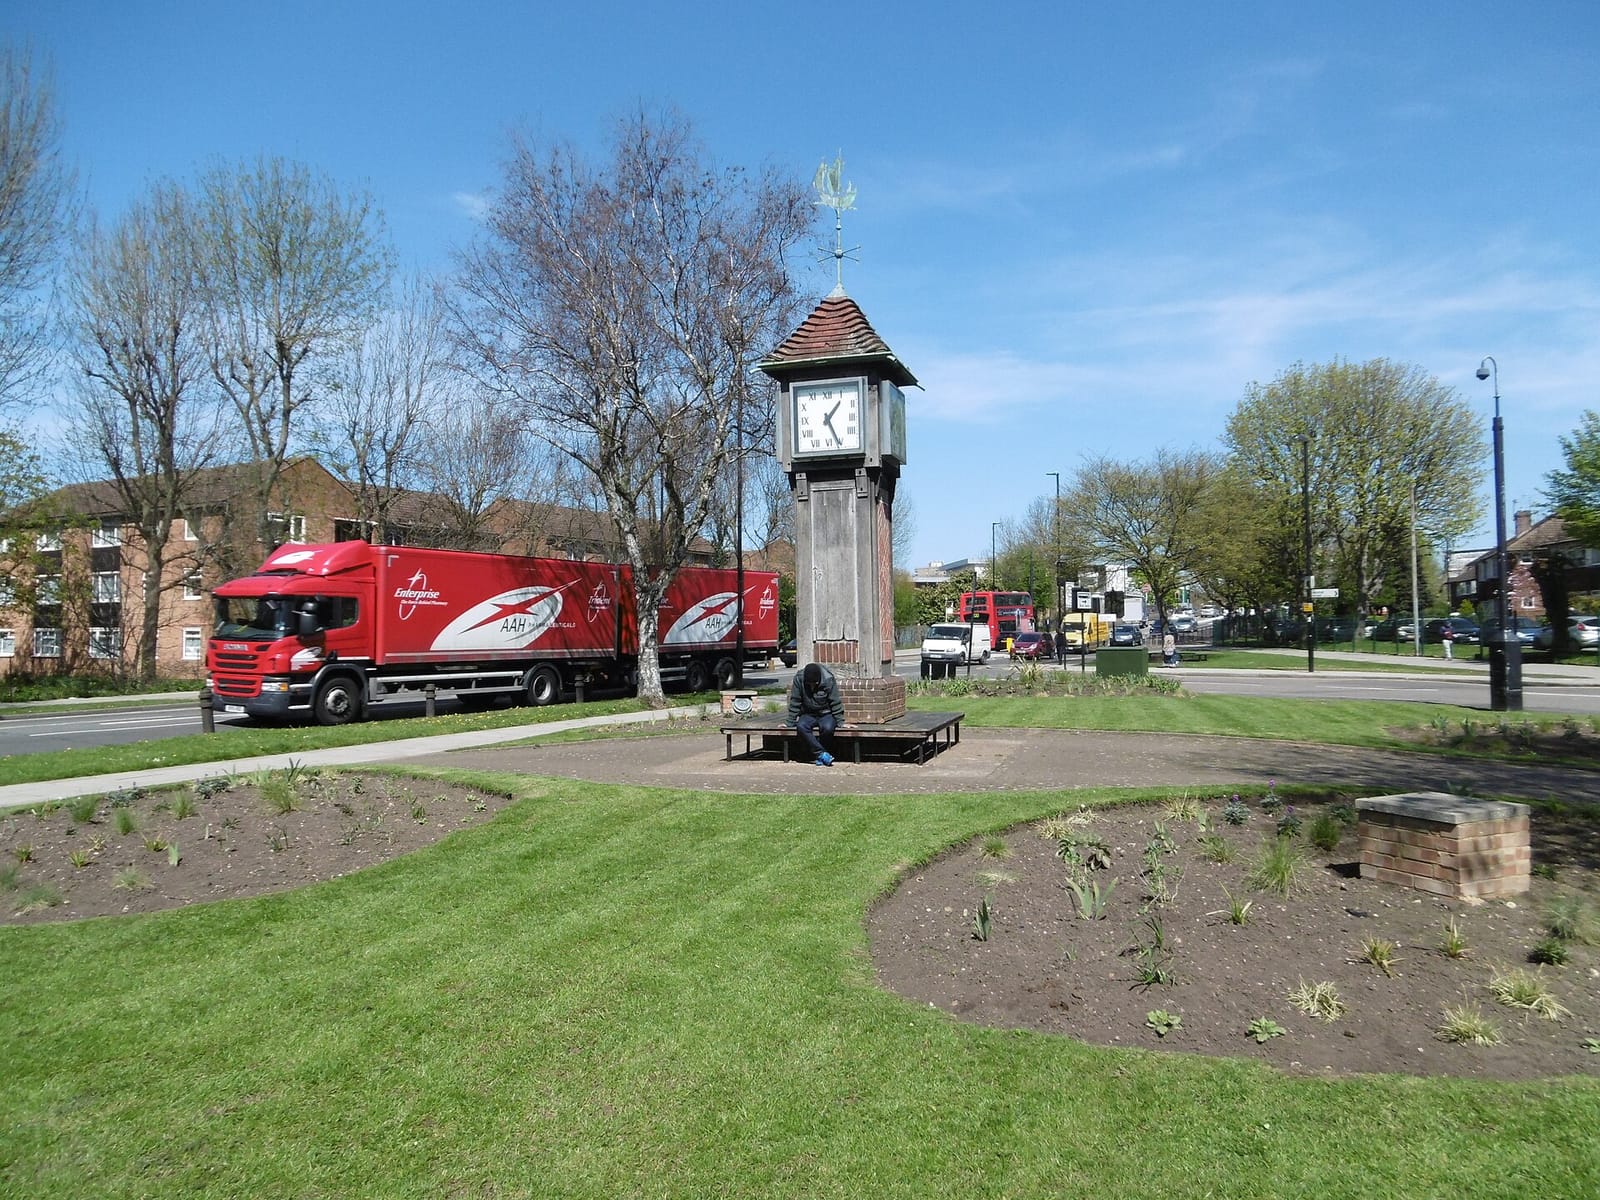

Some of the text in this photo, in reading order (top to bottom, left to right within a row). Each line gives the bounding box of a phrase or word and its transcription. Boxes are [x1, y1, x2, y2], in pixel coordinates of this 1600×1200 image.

[808, 391, 817, 401] XI
[822, 390, 833, 401] XII
[801, 403, 807, 412] X
[801, 416, 809, 426] IX
[848, 412, 856, 422] III
[801, 429, 814, 439] VIII
[847, 426, 856, 435] IIII
[810, 439, 821, 448] VII
[825, 438, 833, 447] VI
[393, 588, 440, 601] Enterprise
[500, 618, 527, 633] AAH
[704, 617, 722, 629] AAH
